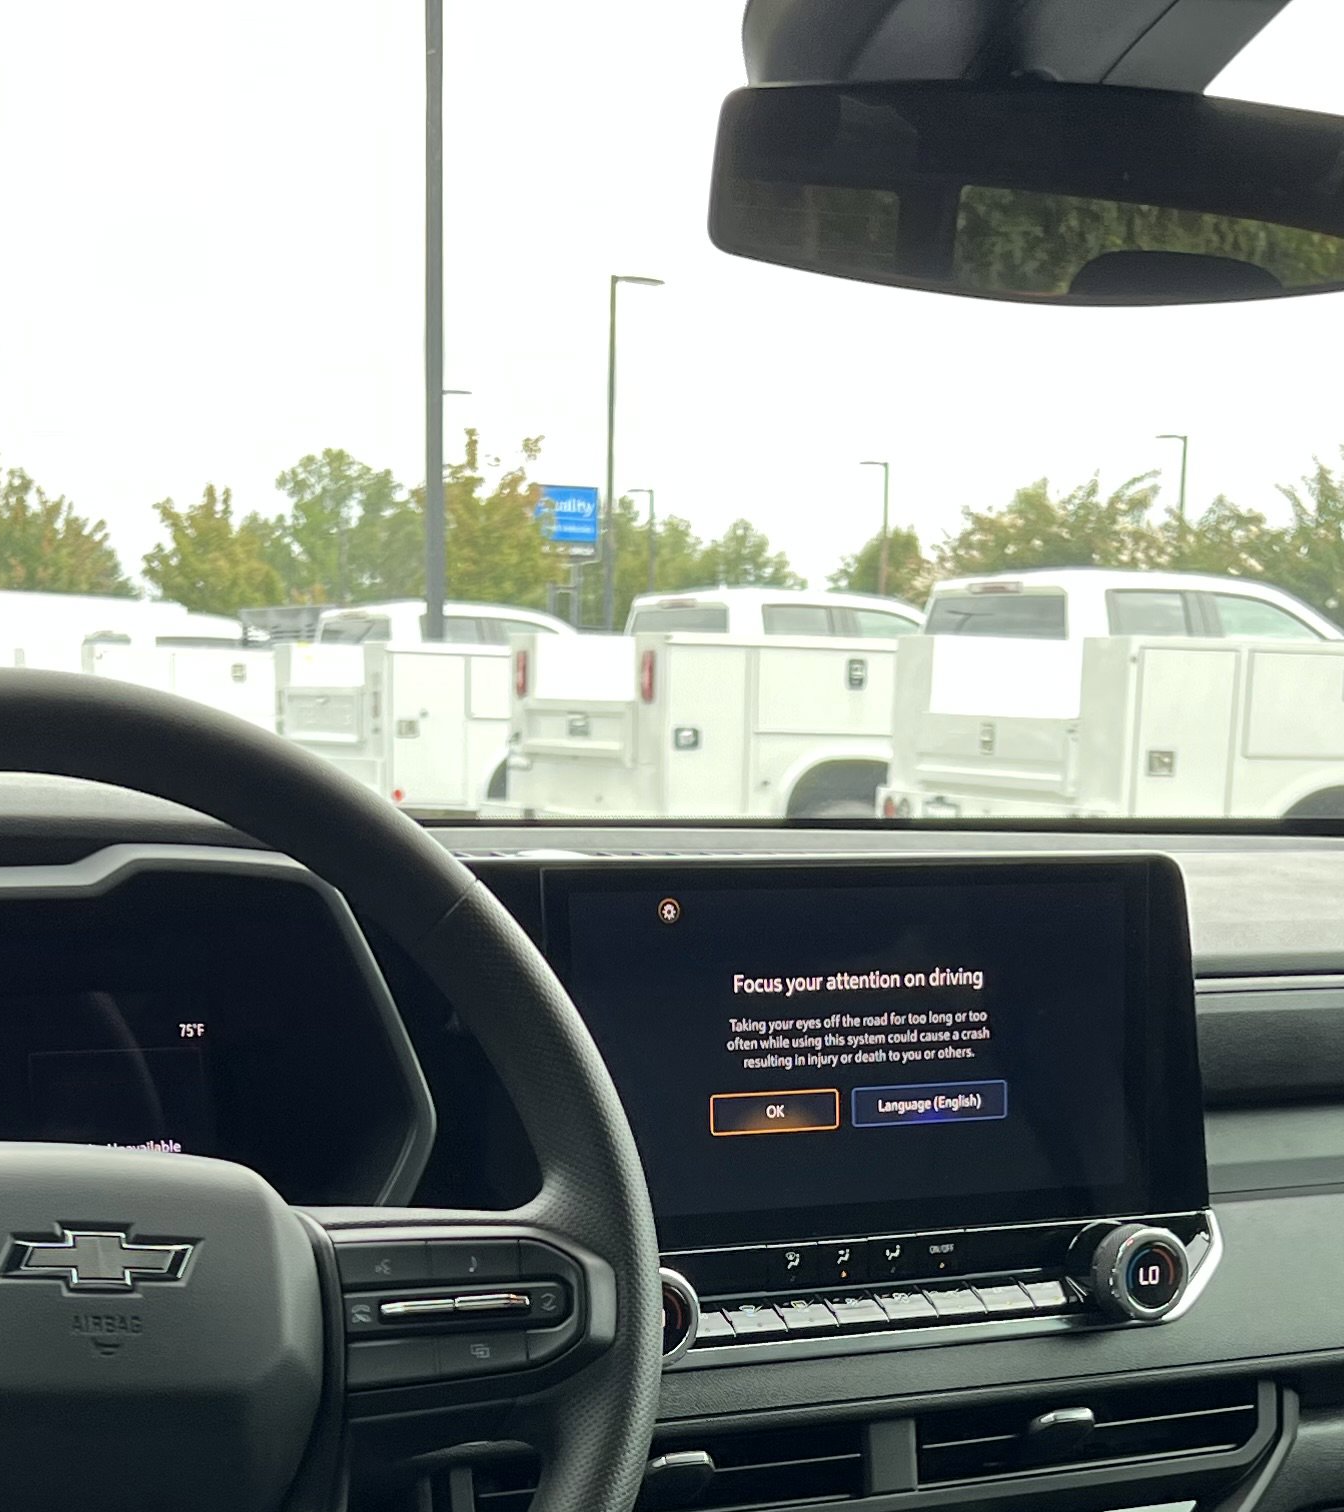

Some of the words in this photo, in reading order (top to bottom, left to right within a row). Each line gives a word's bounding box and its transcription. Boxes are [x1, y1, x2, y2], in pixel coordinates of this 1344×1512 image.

[733, 974, 783, 994] Focus
[785, 976, 824, 997] your
[825, 970, 901, 991] attention
[904, 972, 925, 988] on
[928, 967, 984, 990] driving
[728, 1017, 767, 1034] Taking
[768, 1019, 795, 1034] your
[795, 1018, 822, 1032] eyes
[823, 1014, 841, 1028] off
[842, 1013, 861, 1027] the
[862, 1012, 888, 1027] road
[889, 1011, 907, 1025] for
[907, 1012, 927, 1025] too
[928, 1010, 953, 1027] long
[954, 1012, 967, 1023] or
[968, 1010, 988, 1022] too
[726, 1036, 758, 1051] often
[759, 1035, 790, 1049] while
[791, 1035, 822, 1051] using
[824, 1033, 846, 1047] this
[846, 1033, 886, 1049] system
[887, 1029, 918, 1044] could
[919, 1030, 951, 1042] cause
[952, 1030, 960, 1041] a
[960, 1026, 990, 1041] crash
[743, 1053, 793, 1070] resulting
[794, 1053, 806, 1066] in
[807, 1052, 839, 1068] injury
[840, 1053, 852, 1065] or
[854, 1049, 887, 1063] death
[888, 1050, 901, 1062] to
[901, 1050, 922, 1064] you
[923, 1049, 936, 1060] or
[937, 1045, 975, 1059] others.
[766, 1104, 785, 1119] OK
[878, 1099, 932, 1115] Language
[933, 1093, 982, 1112] (English)
[107, 1139, 181, 1153] vailable
[1139, 1265, 1160, 1286] LO
[72, 1314, 144, 1335] AIRBAG
